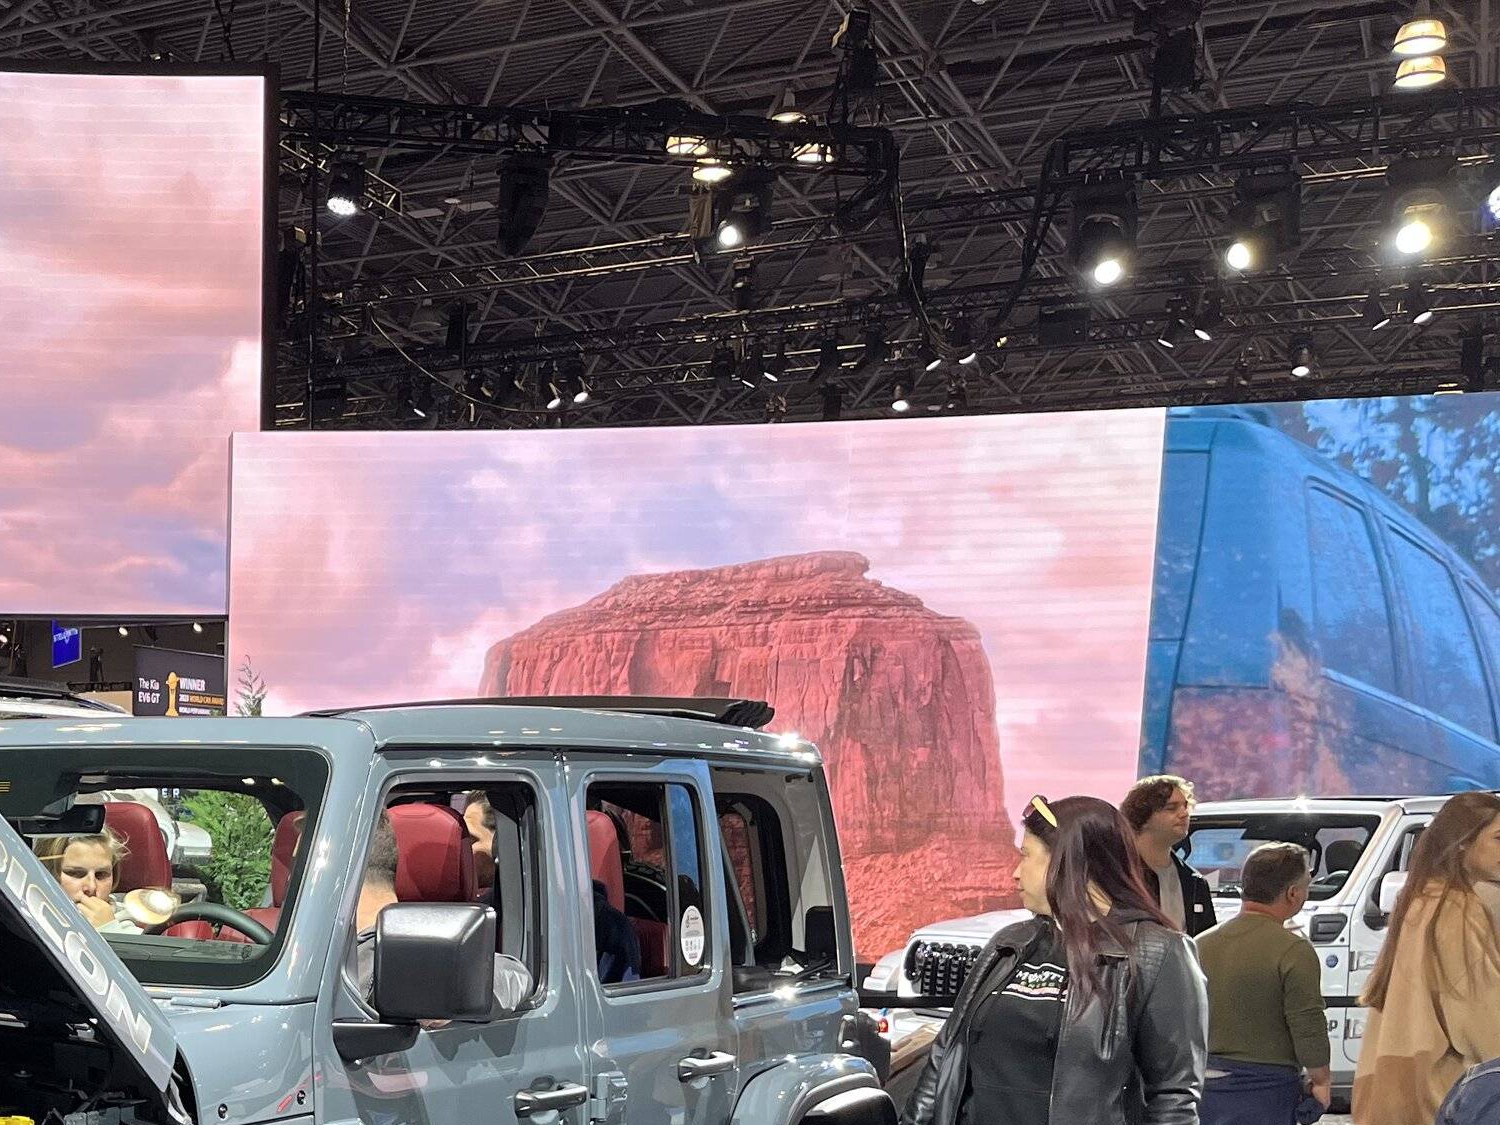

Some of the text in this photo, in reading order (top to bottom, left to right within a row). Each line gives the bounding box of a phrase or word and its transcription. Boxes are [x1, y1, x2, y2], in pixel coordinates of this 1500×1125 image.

[139, 678, 160, 690] The Kia
[179, 677, 206, 691] WINNER
[138, 691, 160, 704] EV6 GT
